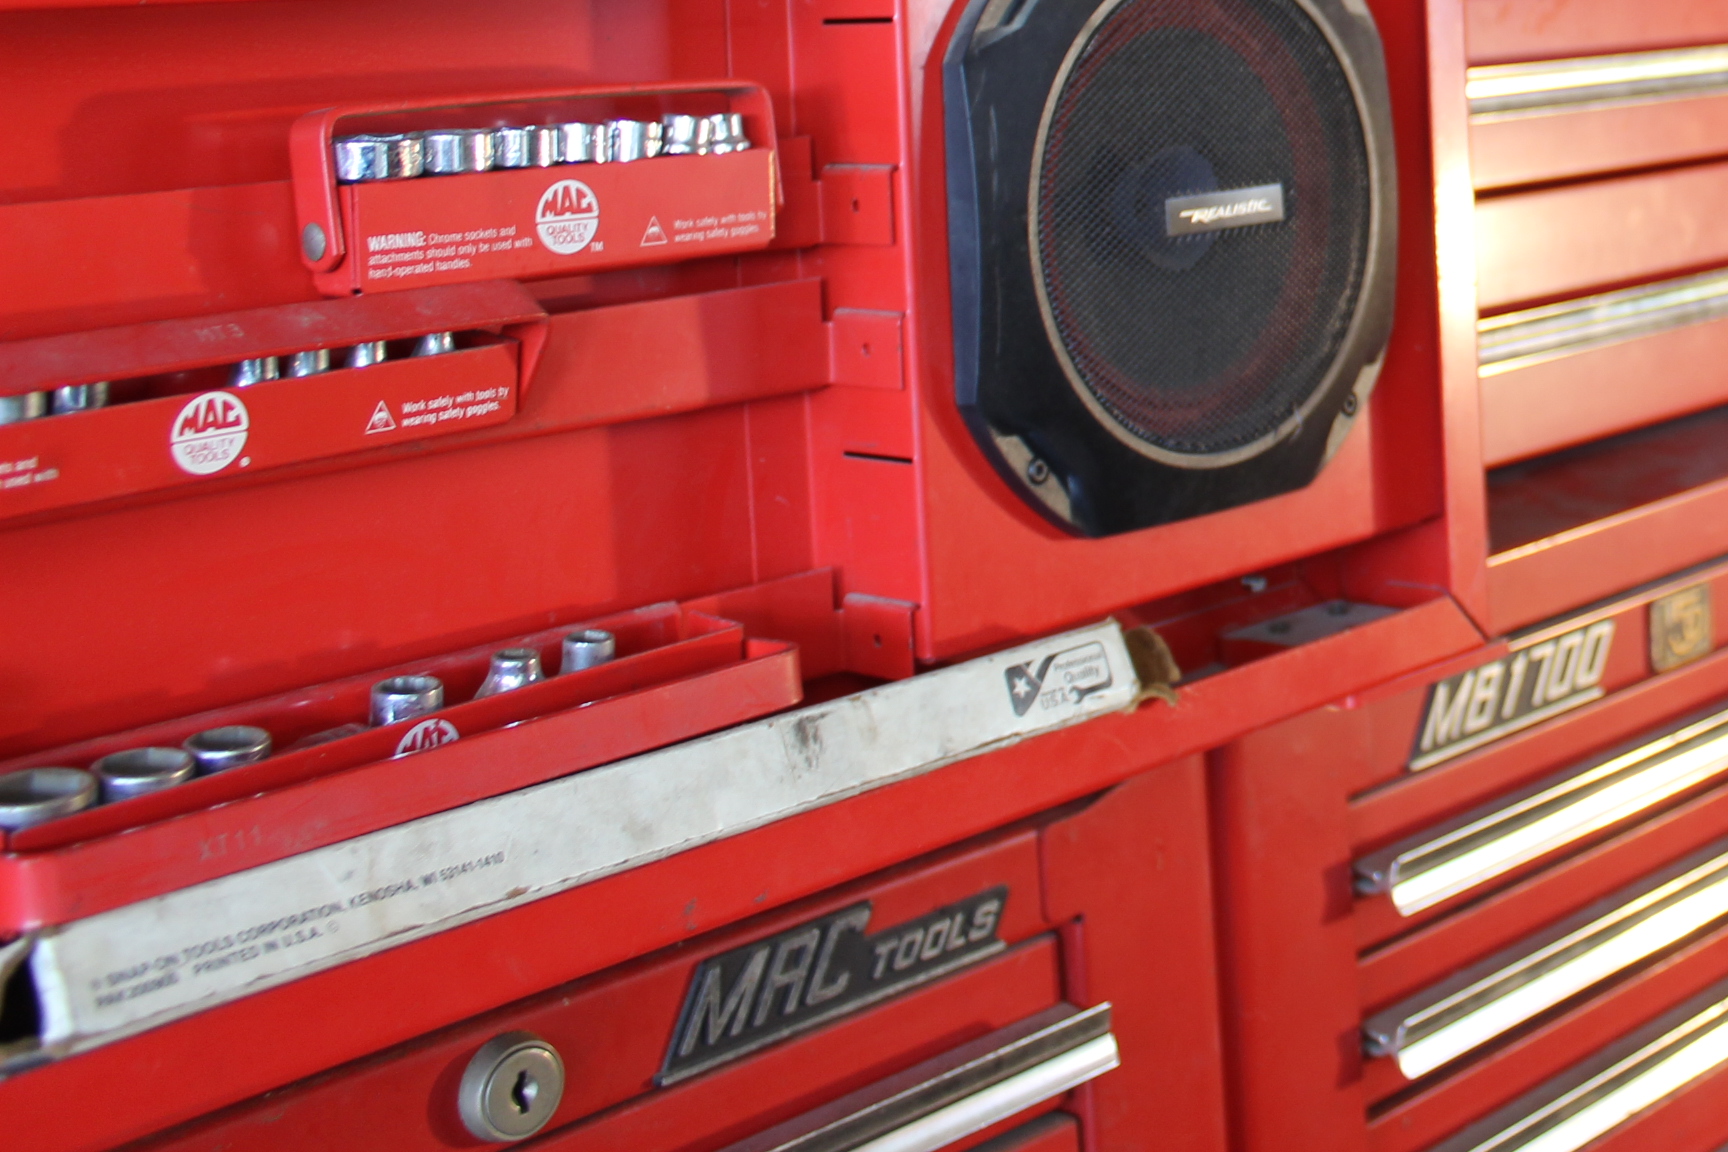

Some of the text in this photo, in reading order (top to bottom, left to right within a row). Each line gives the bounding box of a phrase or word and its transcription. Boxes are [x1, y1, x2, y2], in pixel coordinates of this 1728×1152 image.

[541, 185, 594, 218] MAC
[367, 225, 516, 252] WARNING: Chrome sockets and
[547, 222, 589, 236] QUALITY
[553, 232, 586, 246] TOOLS
[368, 237, 533, 266] attachments should only be used with
[401, 386, 510, 414] Work safely with tools by
[179, 398, 242, 437] MAC
[401, 412, 437, 427] wearing
[438, 407, 465, 421] safety
[183, 436, 236, 456] QUALITY
[190, 449, 230, 465] TOOLS
[1064, 665, 1099, 684] Quality
[181, 934, 234, 961] TOOLS
[192, 945, 261, 978] PRINTED
[262, 939, 280, 954] IN
[680, 899, 999, 1057] MAC TOOLS
